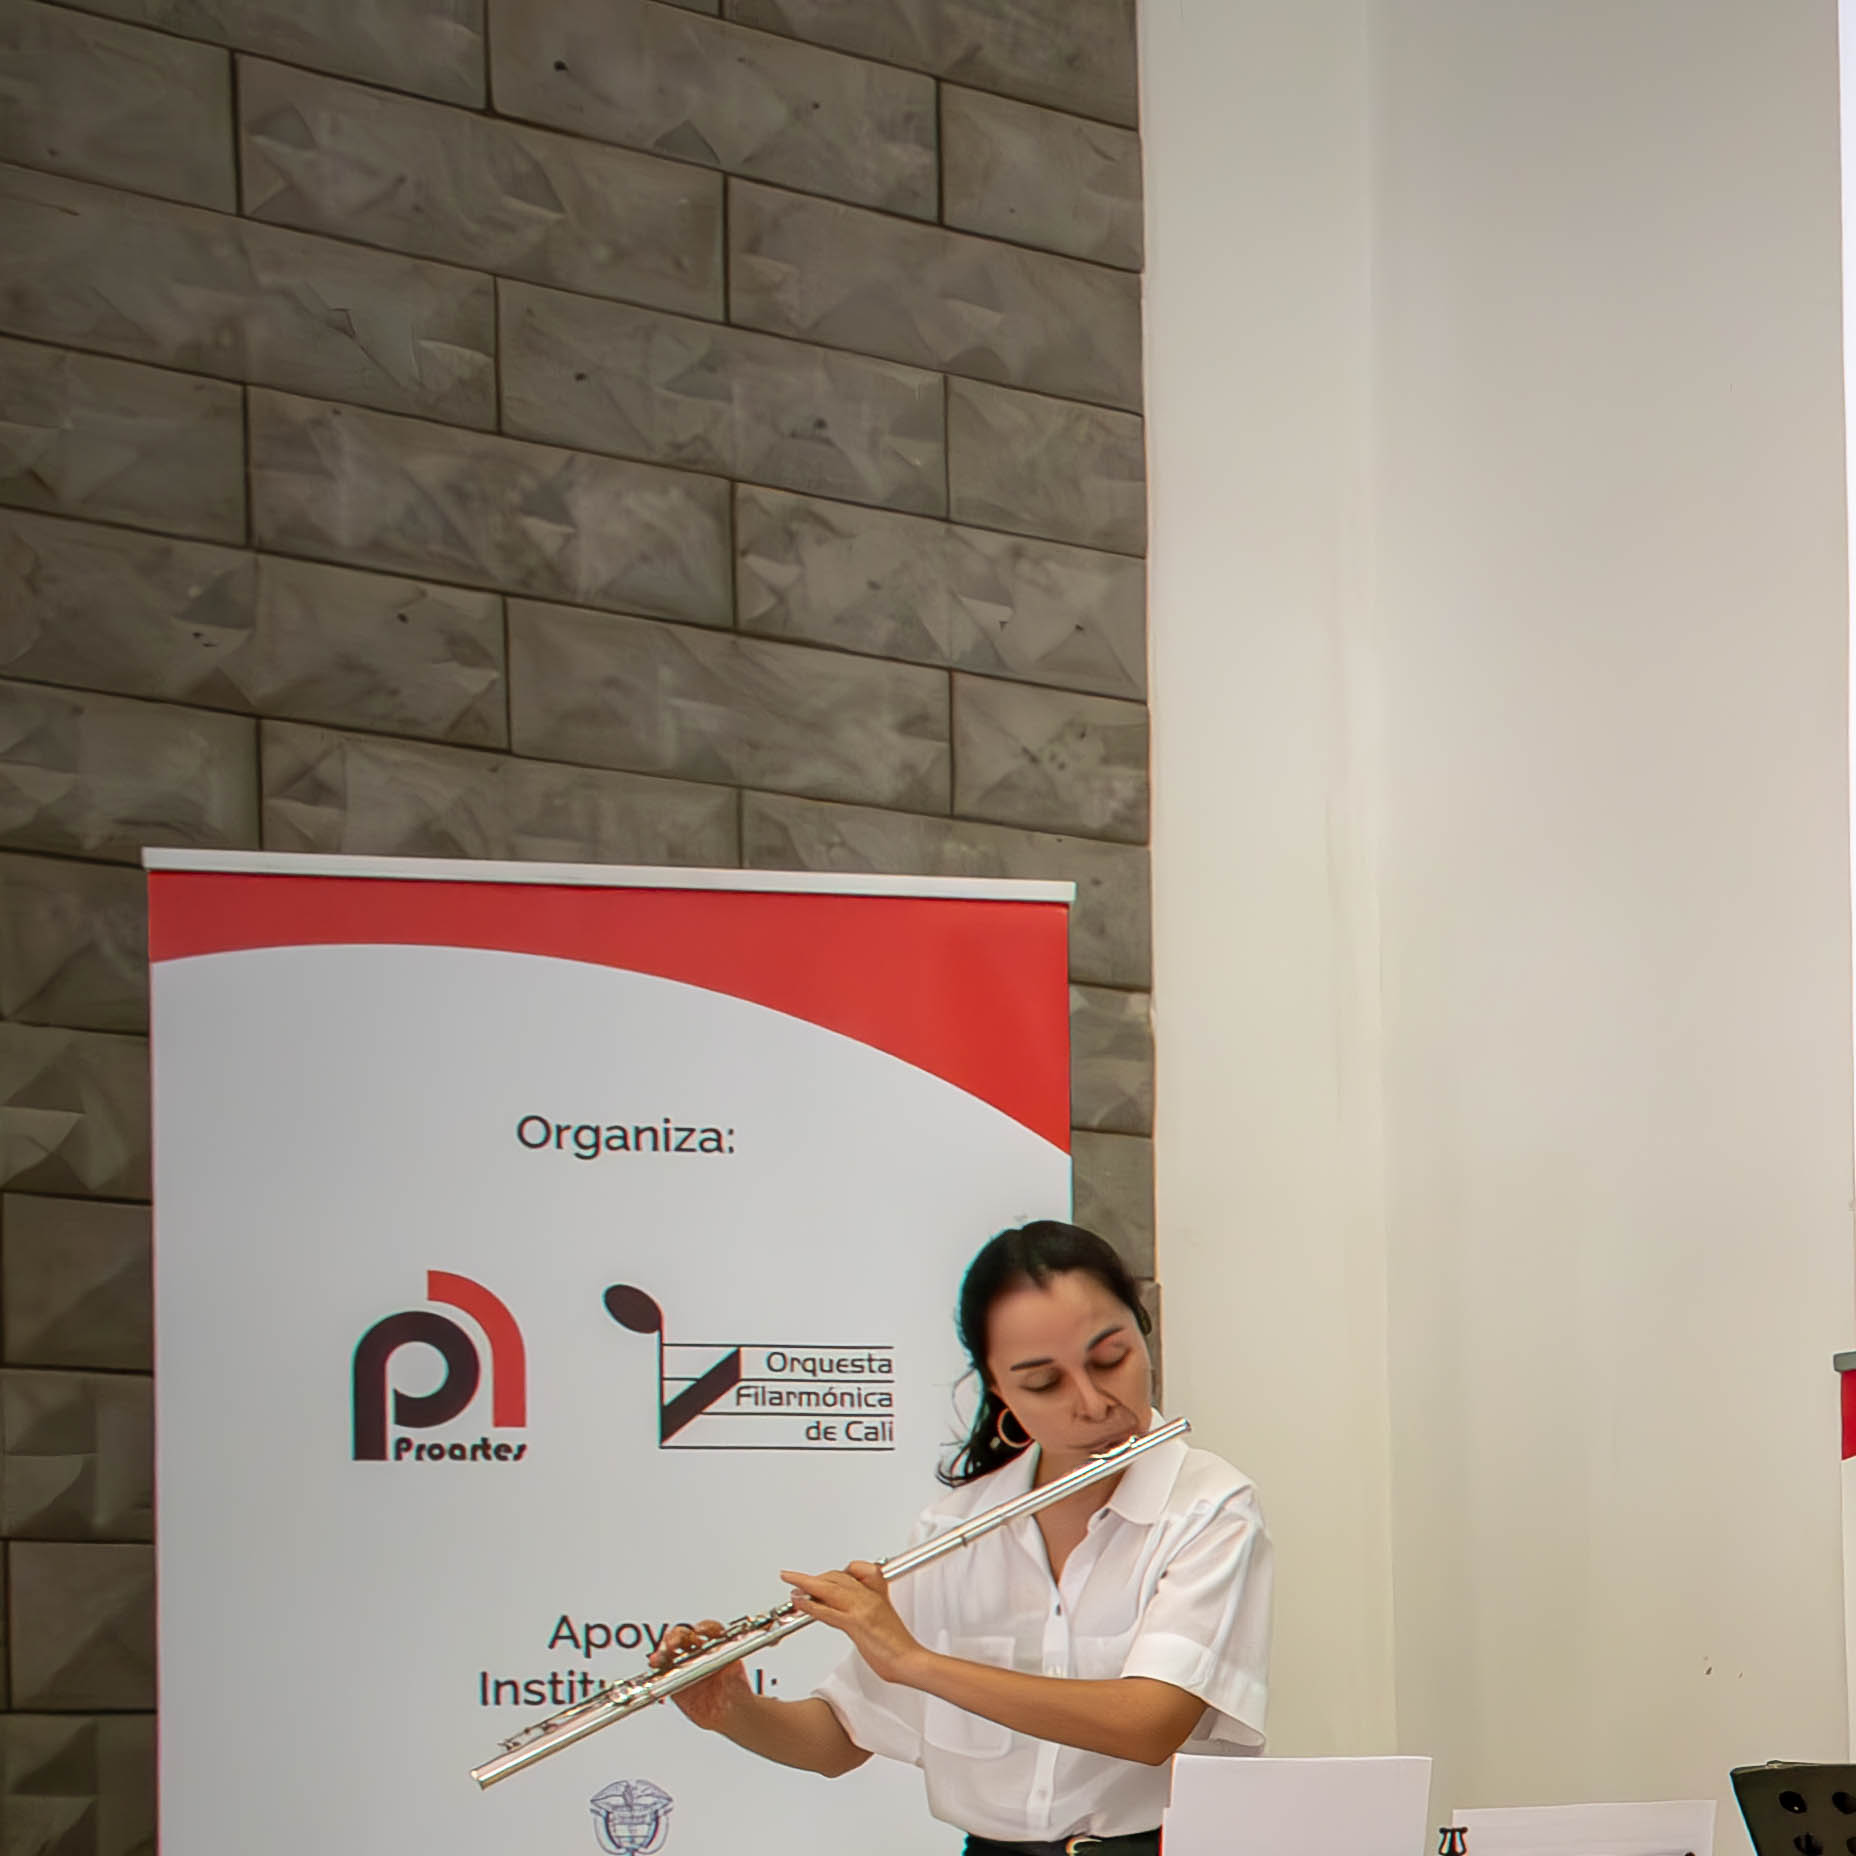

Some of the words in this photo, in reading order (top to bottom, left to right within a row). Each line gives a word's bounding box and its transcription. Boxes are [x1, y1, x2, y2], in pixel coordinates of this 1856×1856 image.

[516, 1115, 735, 1160] Organiza:
[766, 1351, 894, 1377] Orquesta
[735, 1385, 894, 1408] Filarmónica
[805, 1420, 838, 1441] de
[845, 1420, 895, 1442] Cali
[394, 1436, 528, 1461] Proartes
